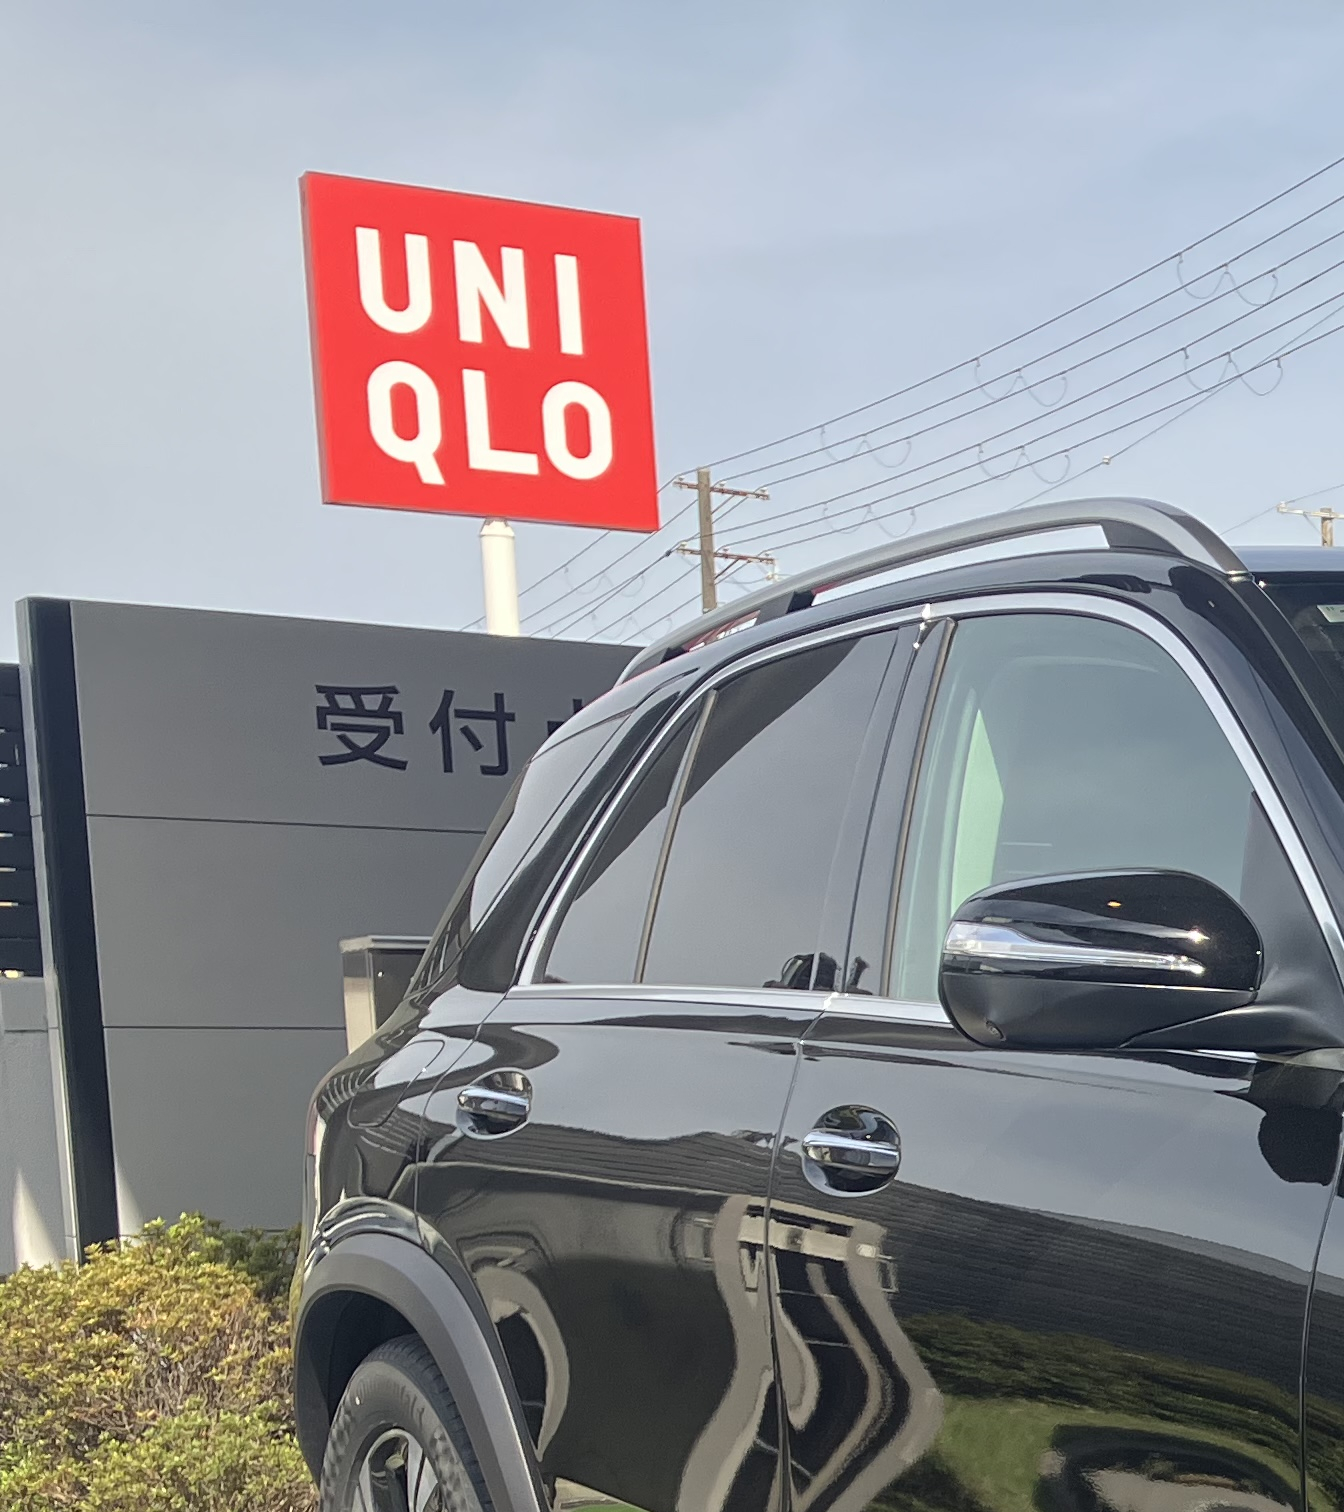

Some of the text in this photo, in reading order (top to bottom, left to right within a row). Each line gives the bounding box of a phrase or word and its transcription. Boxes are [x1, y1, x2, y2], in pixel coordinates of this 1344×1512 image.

[354, 226, 585, 356] UNI
[366, 359, 614, 487] QLO
[315, 684, 583, 777] 受付
